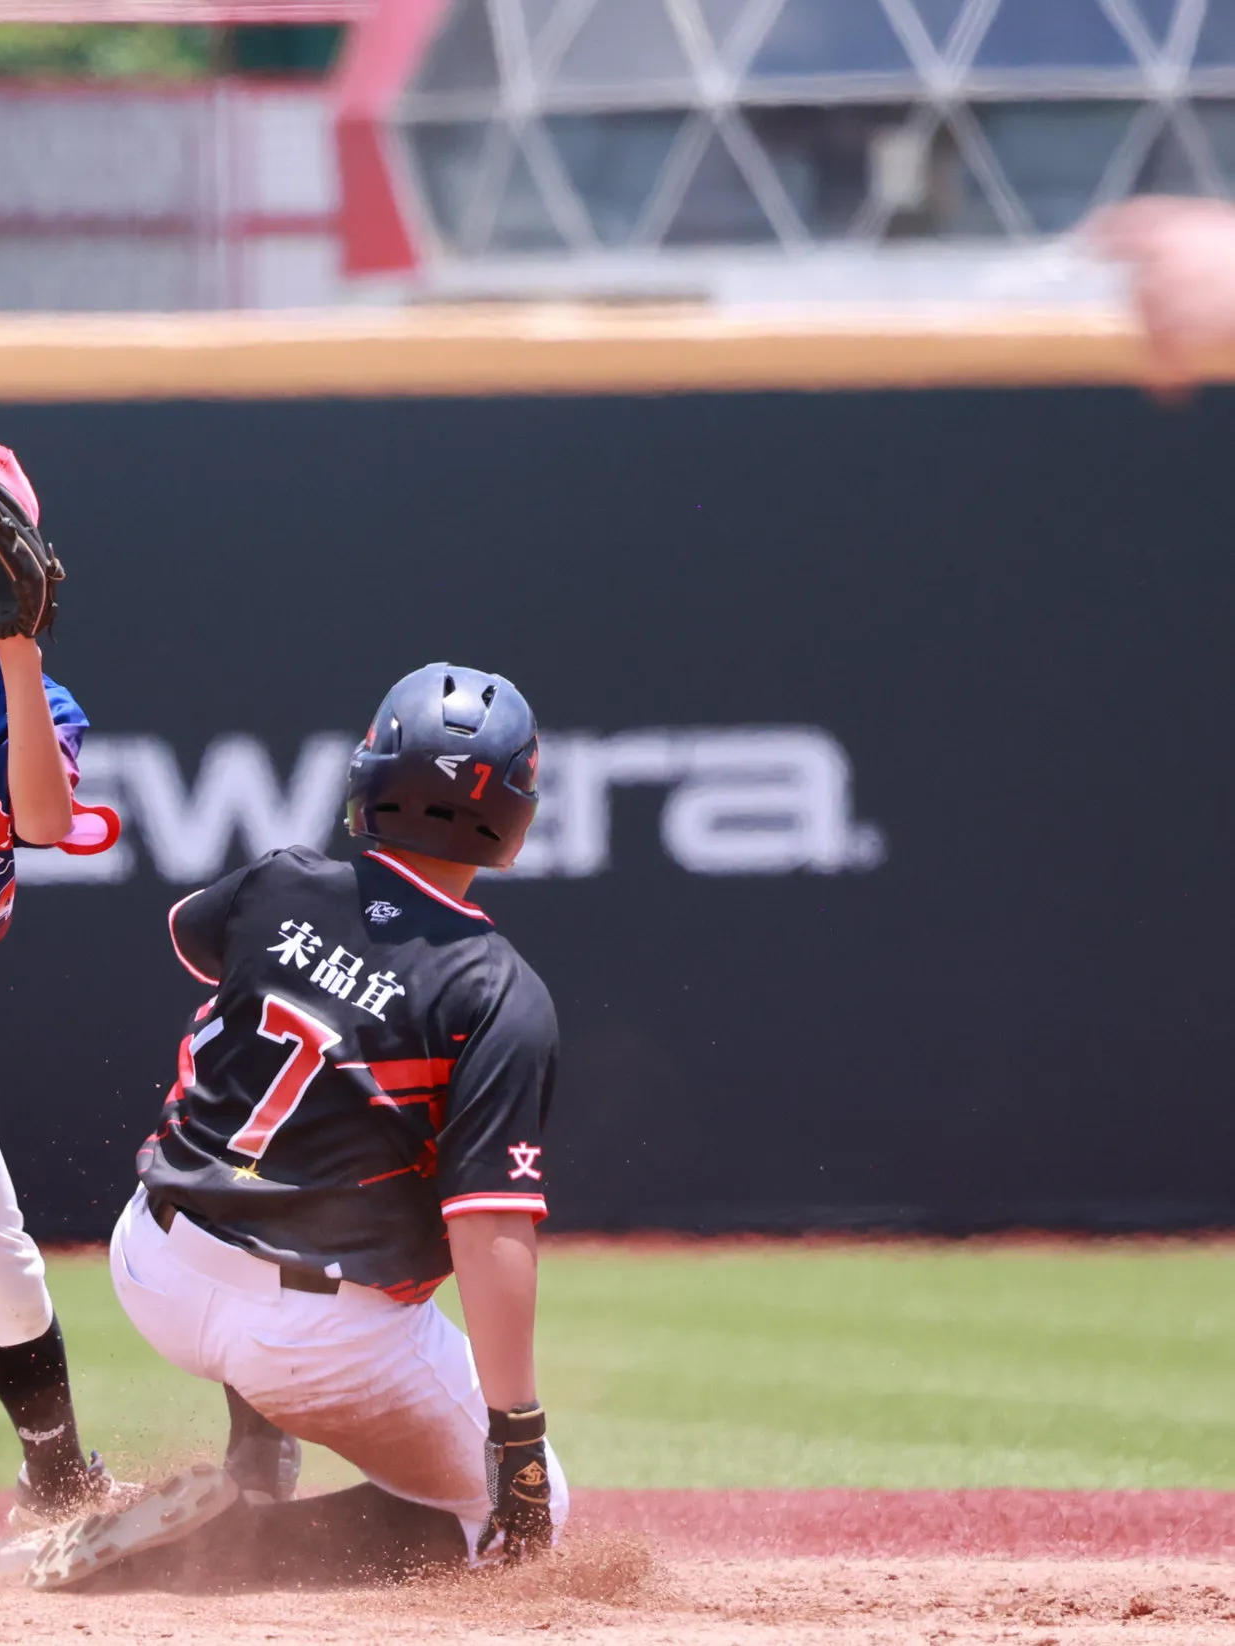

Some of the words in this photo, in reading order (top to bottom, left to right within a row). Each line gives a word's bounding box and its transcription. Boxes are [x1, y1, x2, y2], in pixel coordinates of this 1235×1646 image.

[469, 763, 493, 800] 7
[266, 919, 405, 1022] 宋品宜
[227, 993, 342, 1159] 7
[508, 1141, 542, 1181] 文
